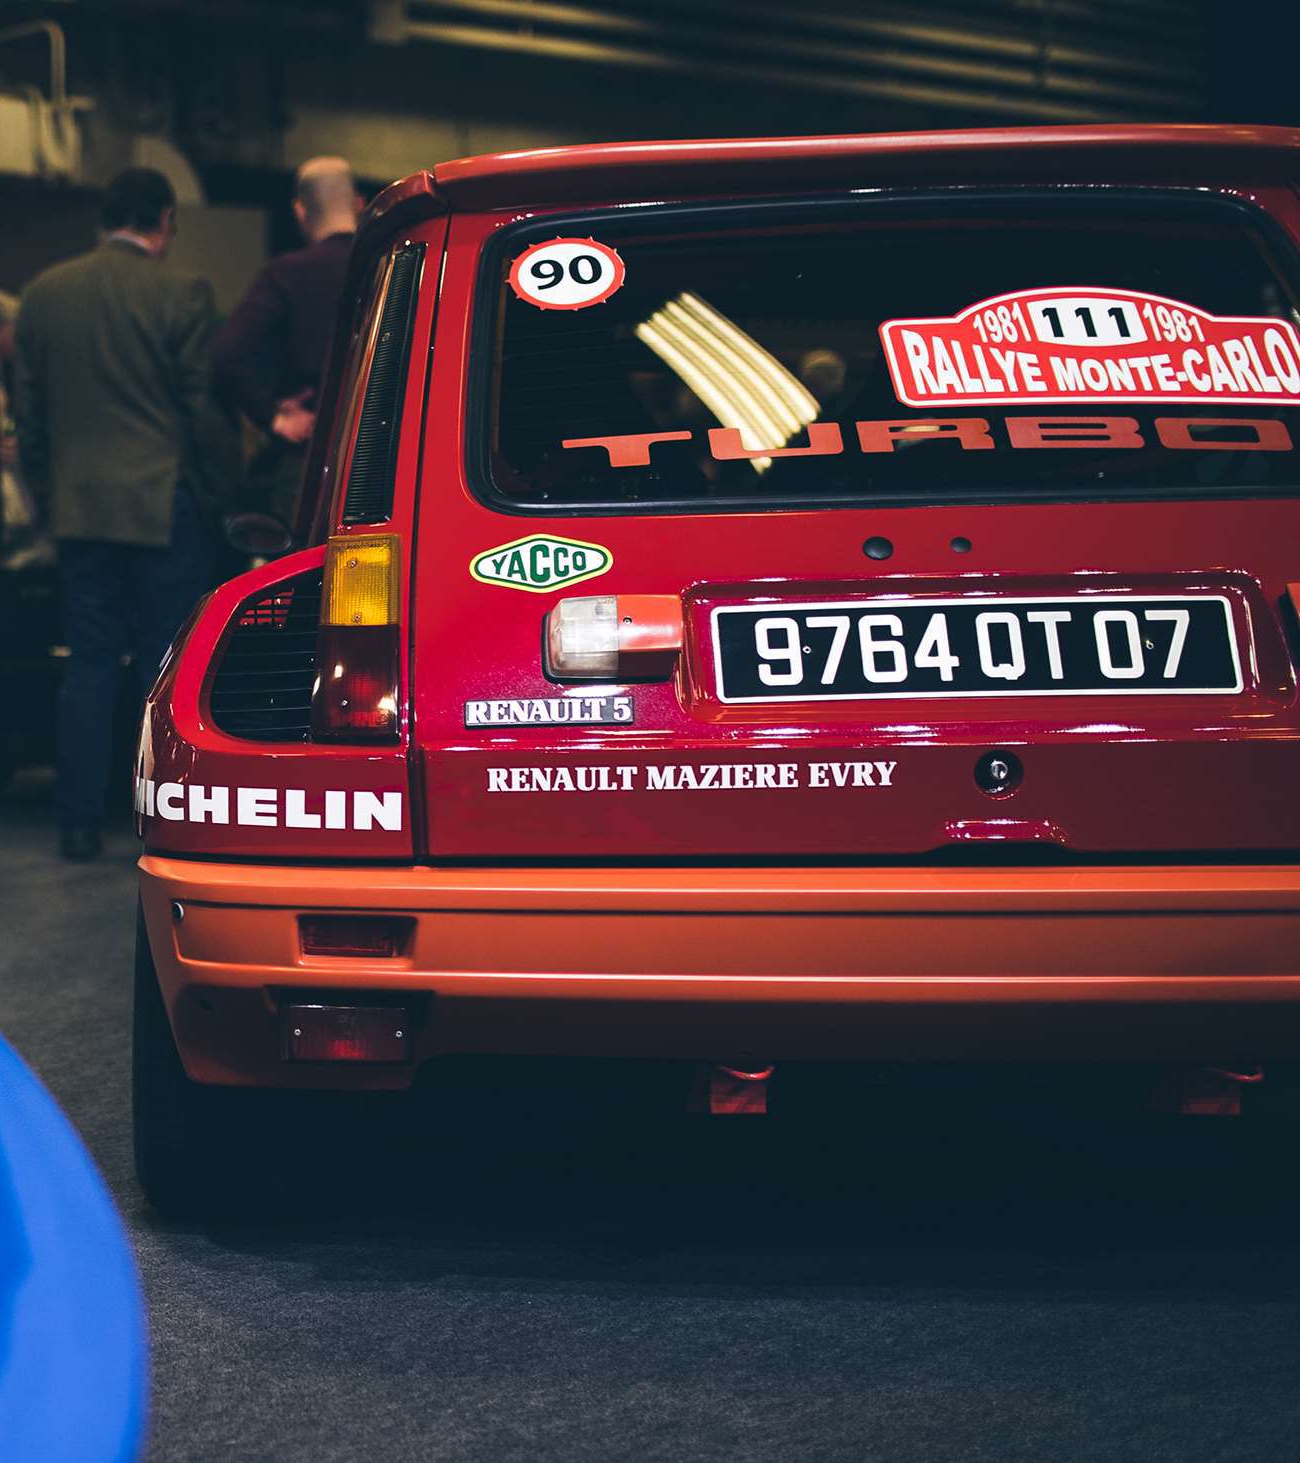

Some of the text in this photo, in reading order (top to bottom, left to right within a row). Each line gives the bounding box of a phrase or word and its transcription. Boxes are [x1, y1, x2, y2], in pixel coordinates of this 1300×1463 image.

[530, 255, 603, 291] 90
[972, 301, 1206, 344] 1981 111 1981
[901, 328, 1300, 395] RALLYE MONTE-CARLO
[562, 417, 1293, 468] TURBO
[492, 544, 588, 579] YACCO
[754, 609, 1191, 686] 9764 QT 07
[465, 697, 632, 725] RENAULT 5
[487, 761, 898, 792] RENAULT MAZIERE EVRY
